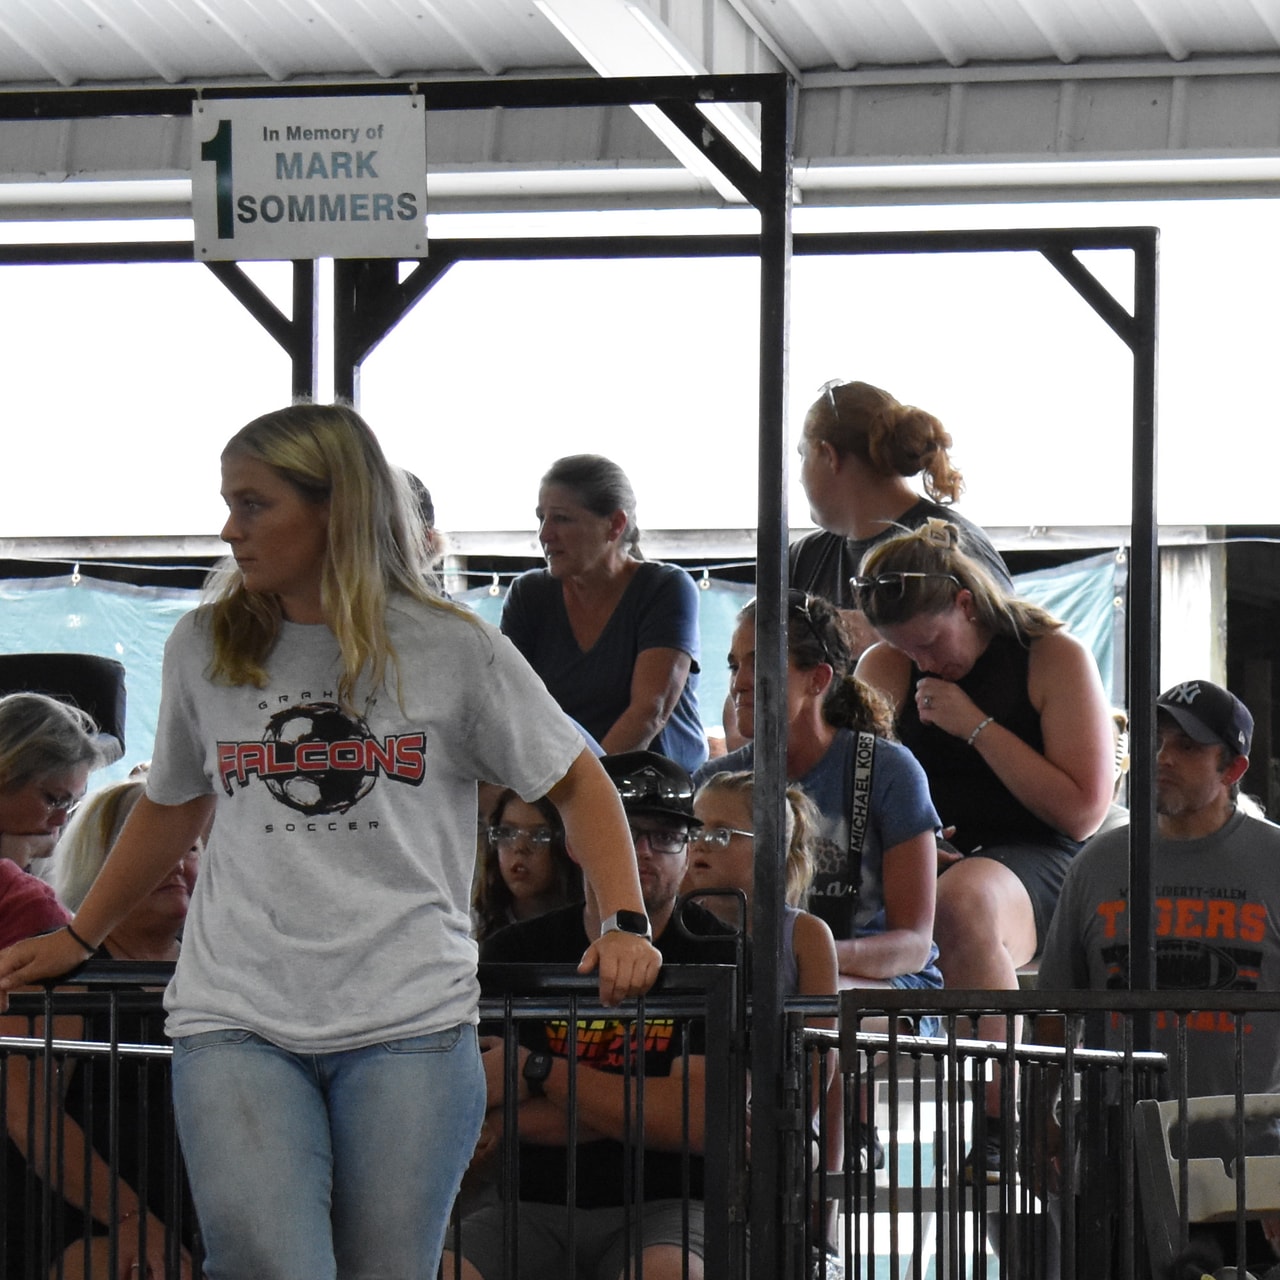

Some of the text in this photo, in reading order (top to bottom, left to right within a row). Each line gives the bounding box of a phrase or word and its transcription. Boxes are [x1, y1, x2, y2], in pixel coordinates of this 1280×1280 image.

[263, 124, 384, 143] In Memory of
[201, 119, 234, 239] 1
[275, 151, 379, 180] MARK
[236, 192, 418, 224] SOMMERS
[216, 732, 428, 797] FALCONS
[850, 735, 874, 851] MICHAEL KORS
[264, 820, 380, 834] SOCCER
[1154, 885, 1248, 901] LIBERTY-SALEM
[1096, 897, 1268, 943] TGERS
